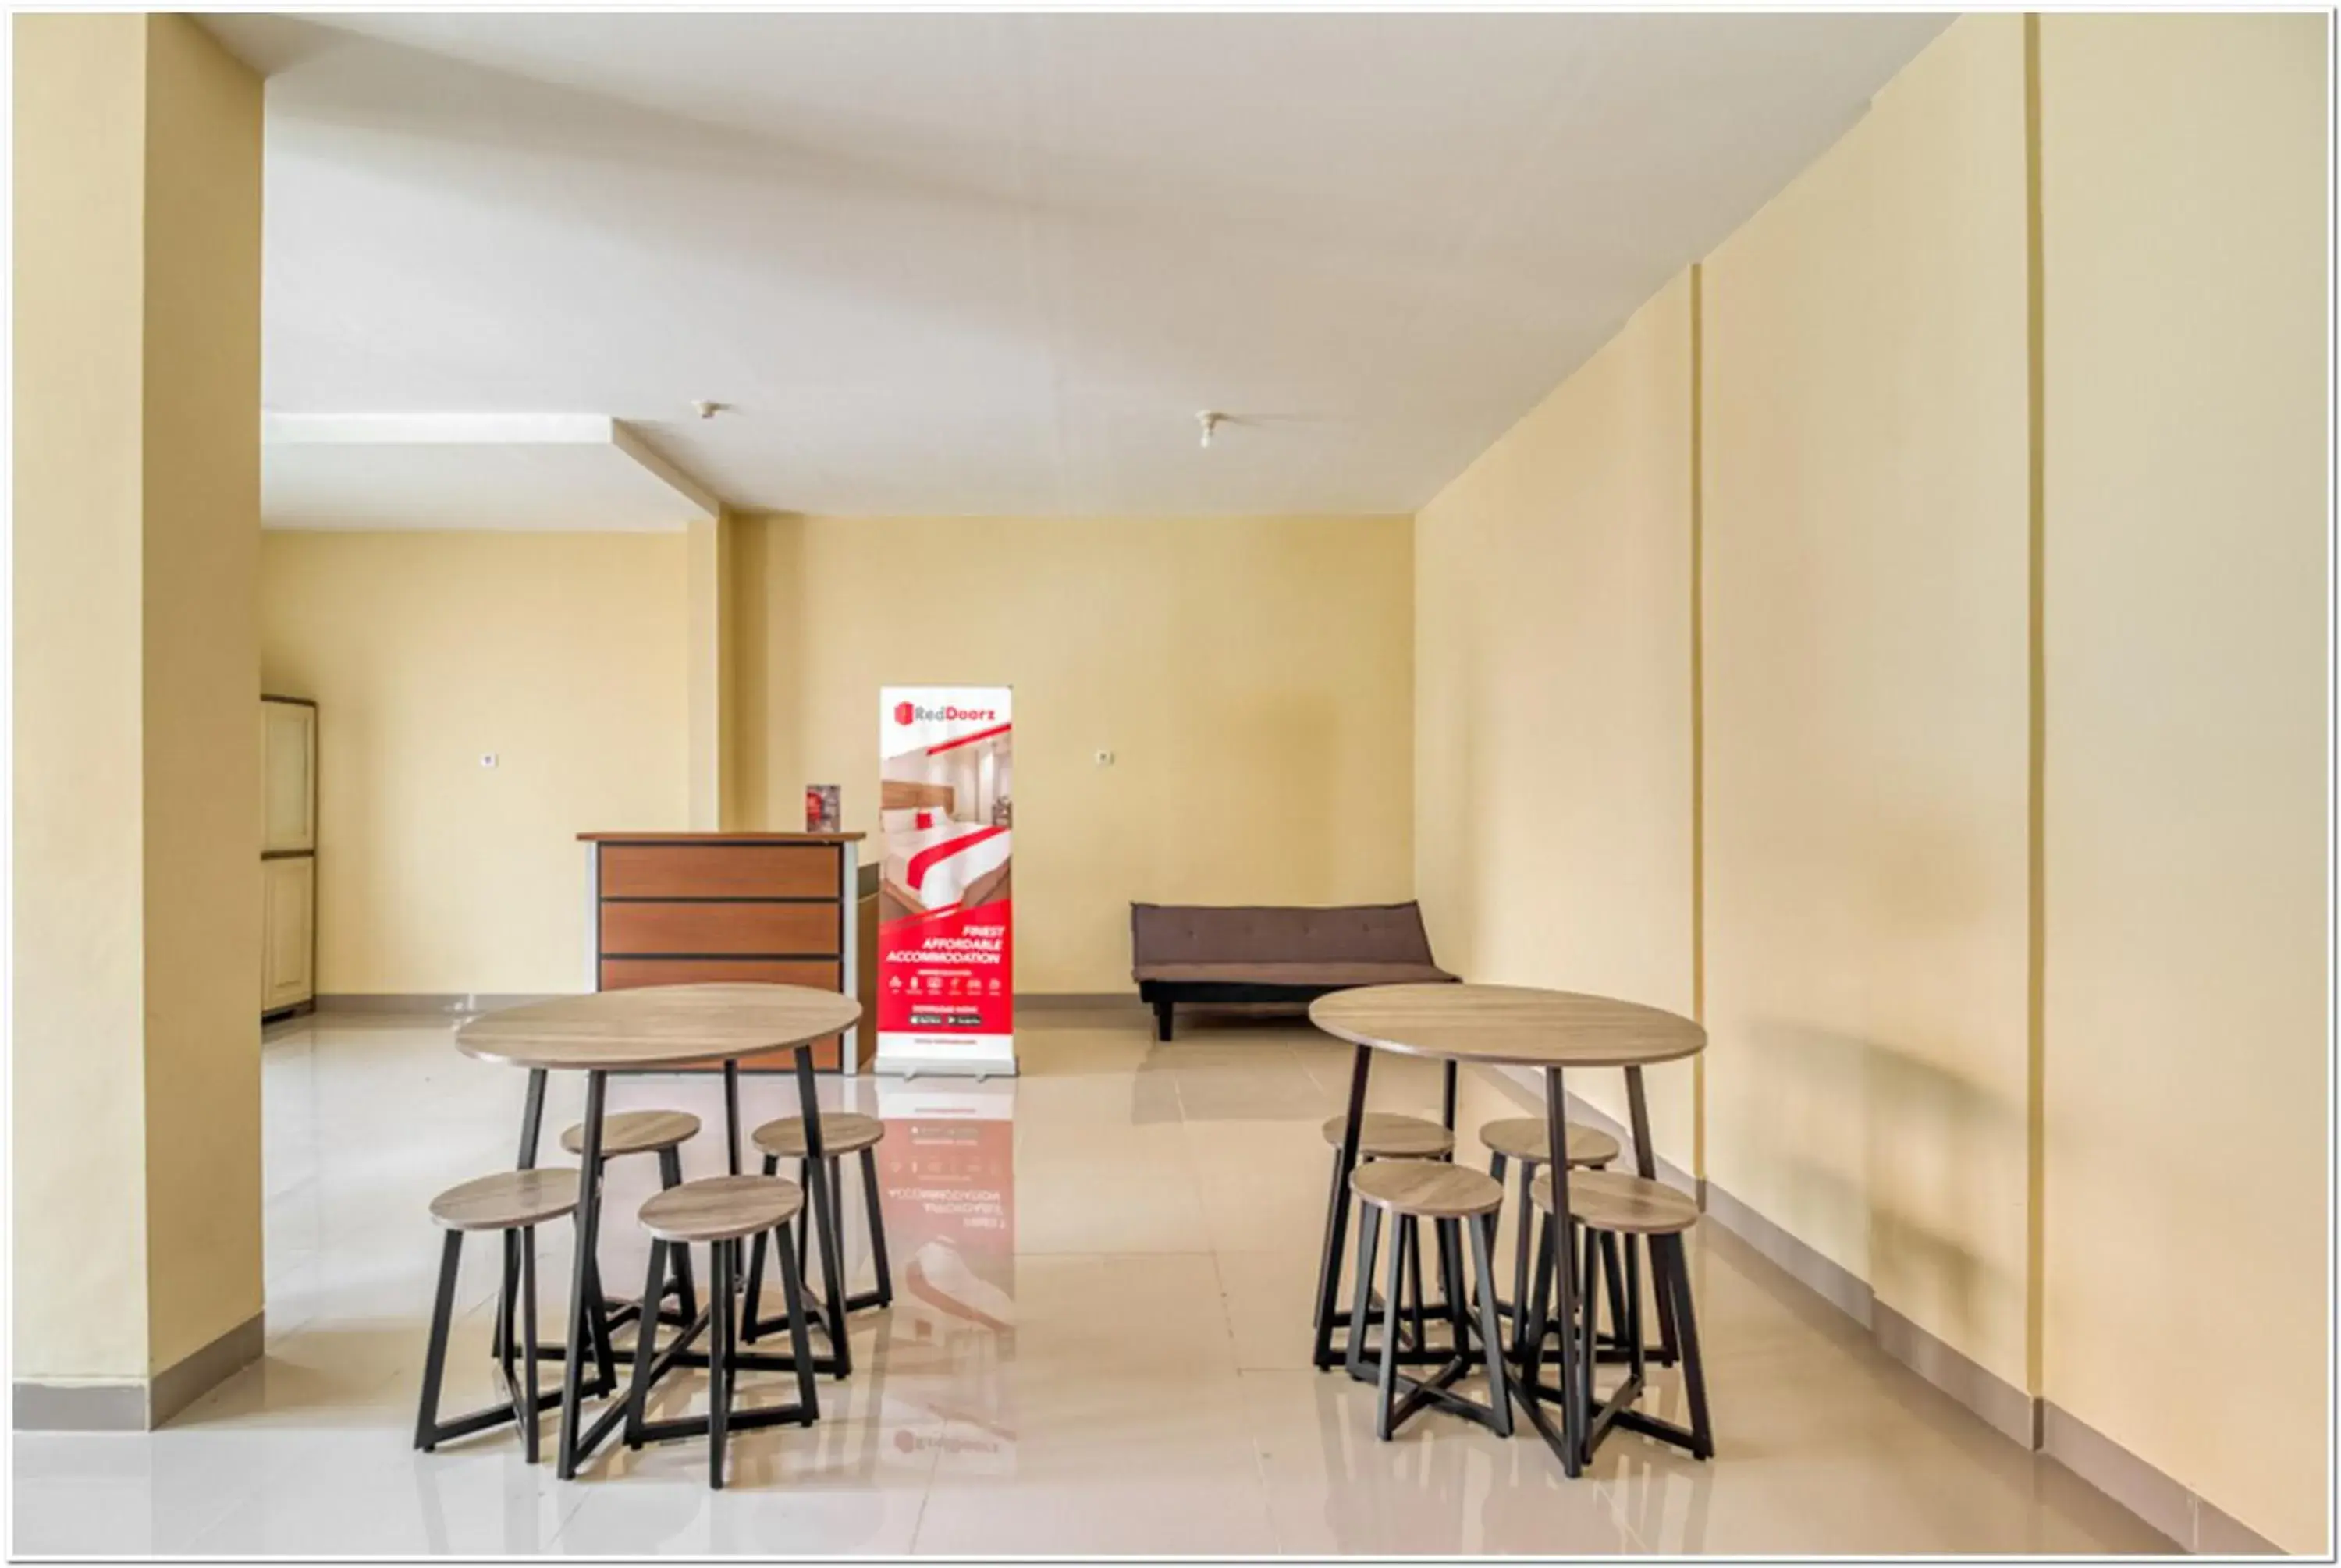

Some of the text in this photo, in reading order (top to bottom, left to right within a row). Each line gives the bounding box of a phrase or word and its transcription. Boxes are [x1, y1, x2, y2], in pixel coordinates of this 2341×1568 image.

[915, 706, 996, 720] RedDoorz
[962, 925, 1004, 936] FINEST
[922, 938, 1002, 950] AFFORDABLE
[886, 951, 1000, 963] ACCOMMODATION
